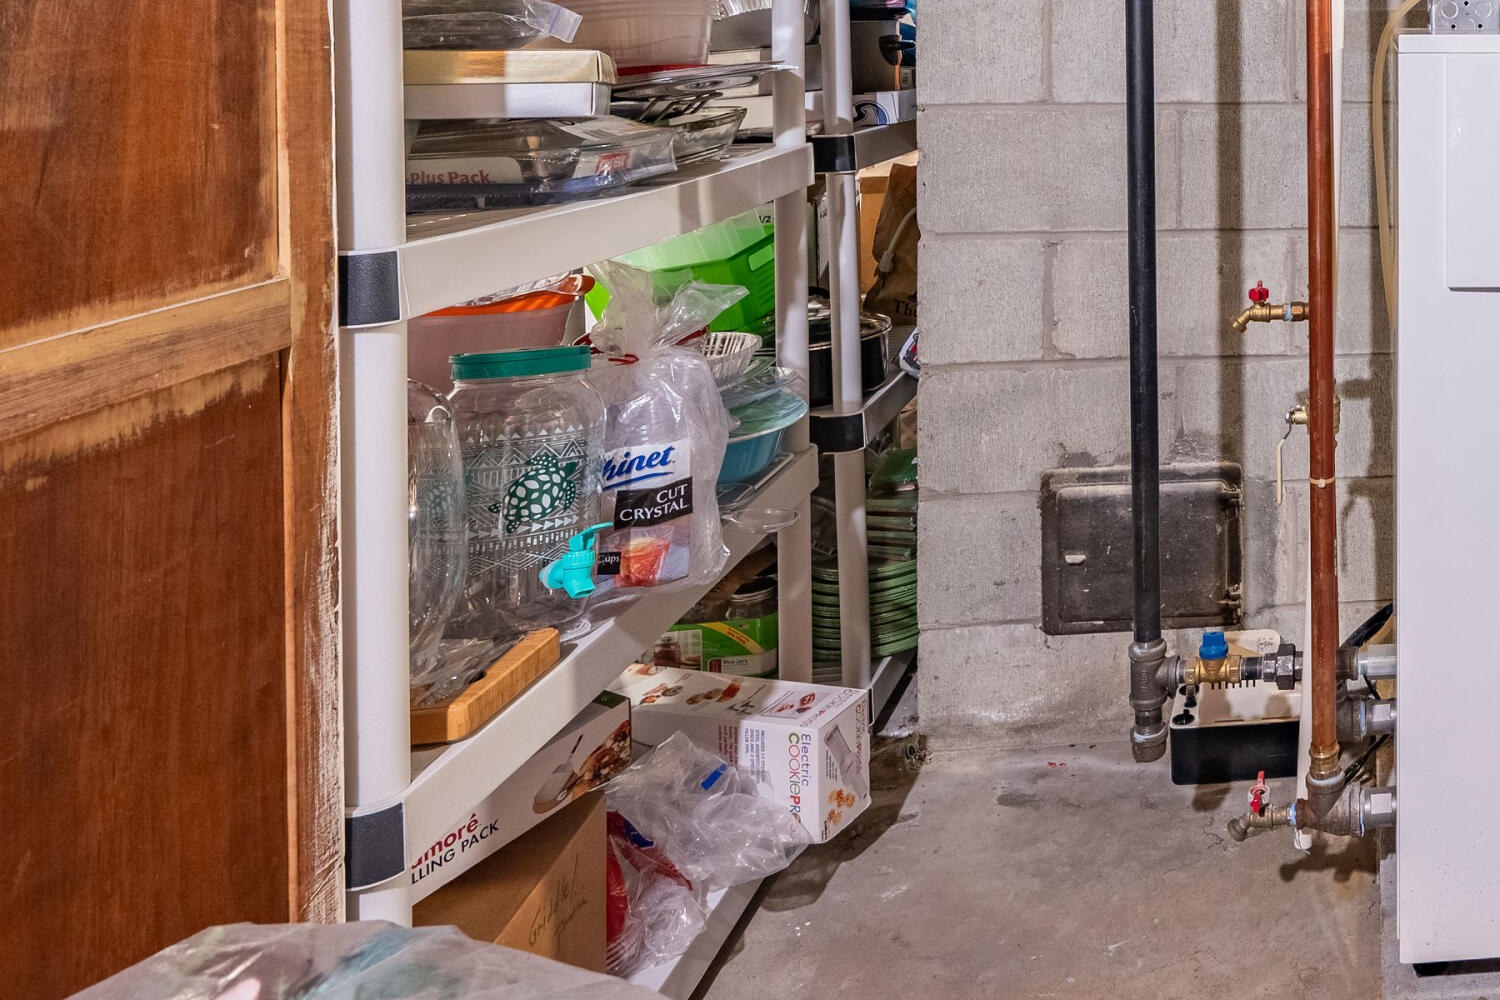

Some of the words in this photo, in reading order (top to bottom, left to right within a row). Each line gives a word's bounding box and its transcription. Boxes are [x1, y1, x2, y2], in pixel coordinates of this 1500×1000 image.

[410, 171, 445, 185] Plus
[447, 169, 491, 185] Pack
[602, 446, 676, 481] hinet
[656, 483, 688, 504] CUT
[619, 498, 688, 522] CRYSTAL
[801, 733, 812, 787] Electric
[411, 850, 456, 886] LLING
[461, 819, 499, 853] PACK
